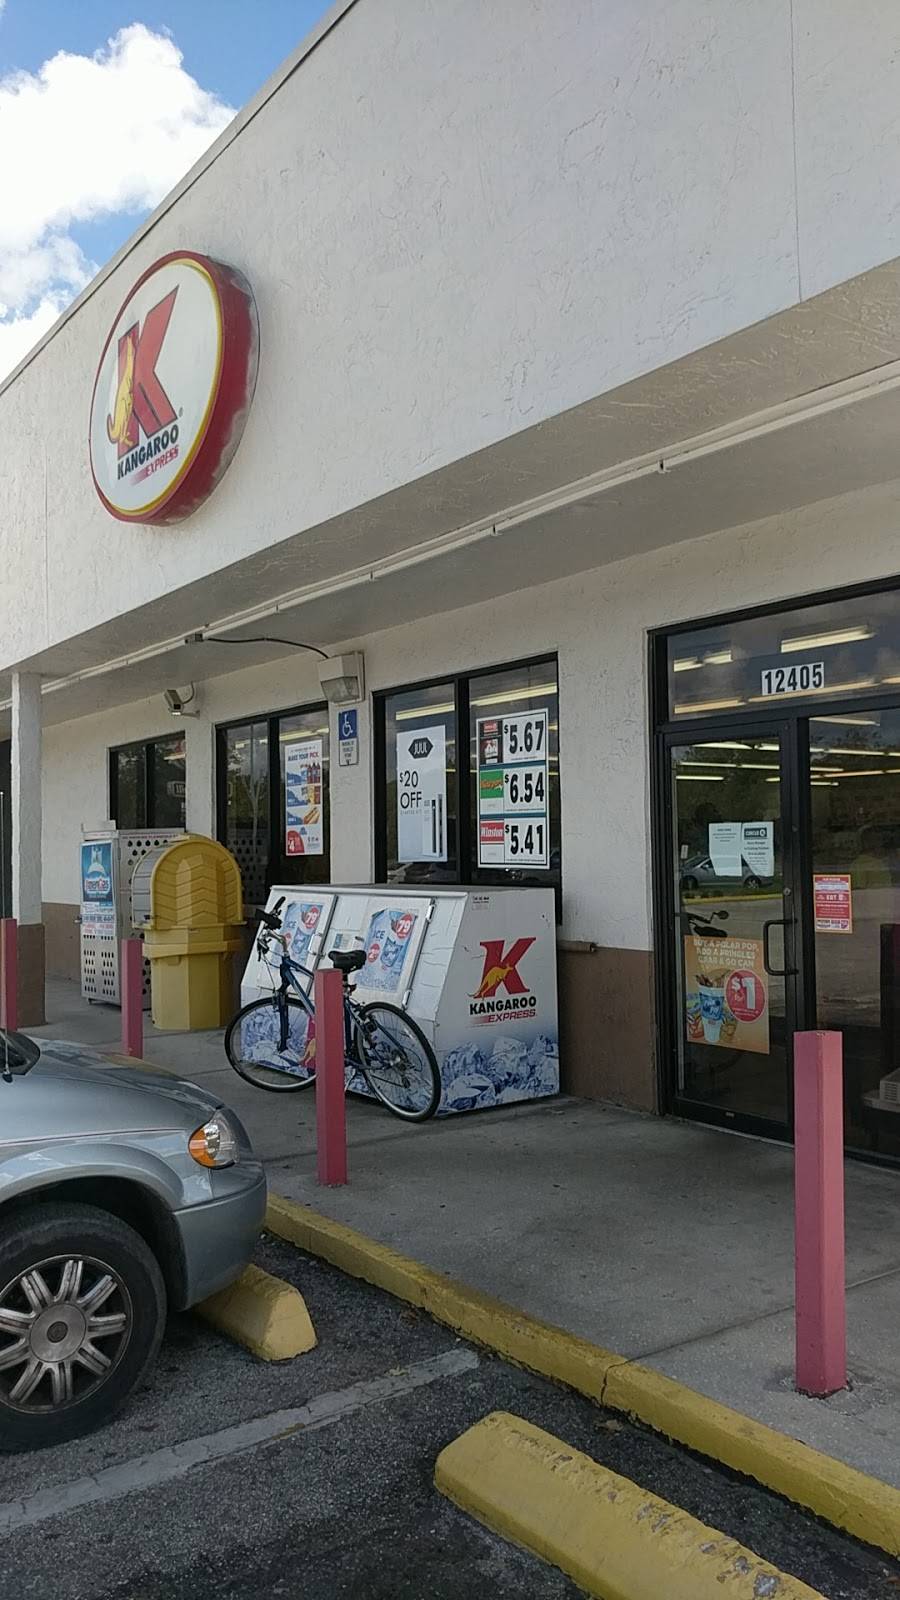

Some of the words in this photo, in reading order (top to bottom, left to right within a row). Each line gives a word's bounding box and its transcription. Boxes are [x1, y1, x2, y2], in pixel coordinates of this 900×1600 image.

[117, 284, 179, 461] K
[117, 424, 179, 480] KANGAROO
[145, 446, 179, 477] EXPRESS
[764, 663, 823, 695] 12405
[503, 720, 544, 754] $5.67
[399, 770, 419, 788] $20
[504, 771, 544, 804] $6.54
[400, 791, 422, 809] OFF
[504, 824, 544, 855] $5.41
[373, 930, 386, 940] ICE
[473, 936, 537, 999] K
[469, 996, 537, 1015] KANGAROO
[731, 975, 756, 1010] $1
[488, 1009, 536, 1023] EXPRESS
